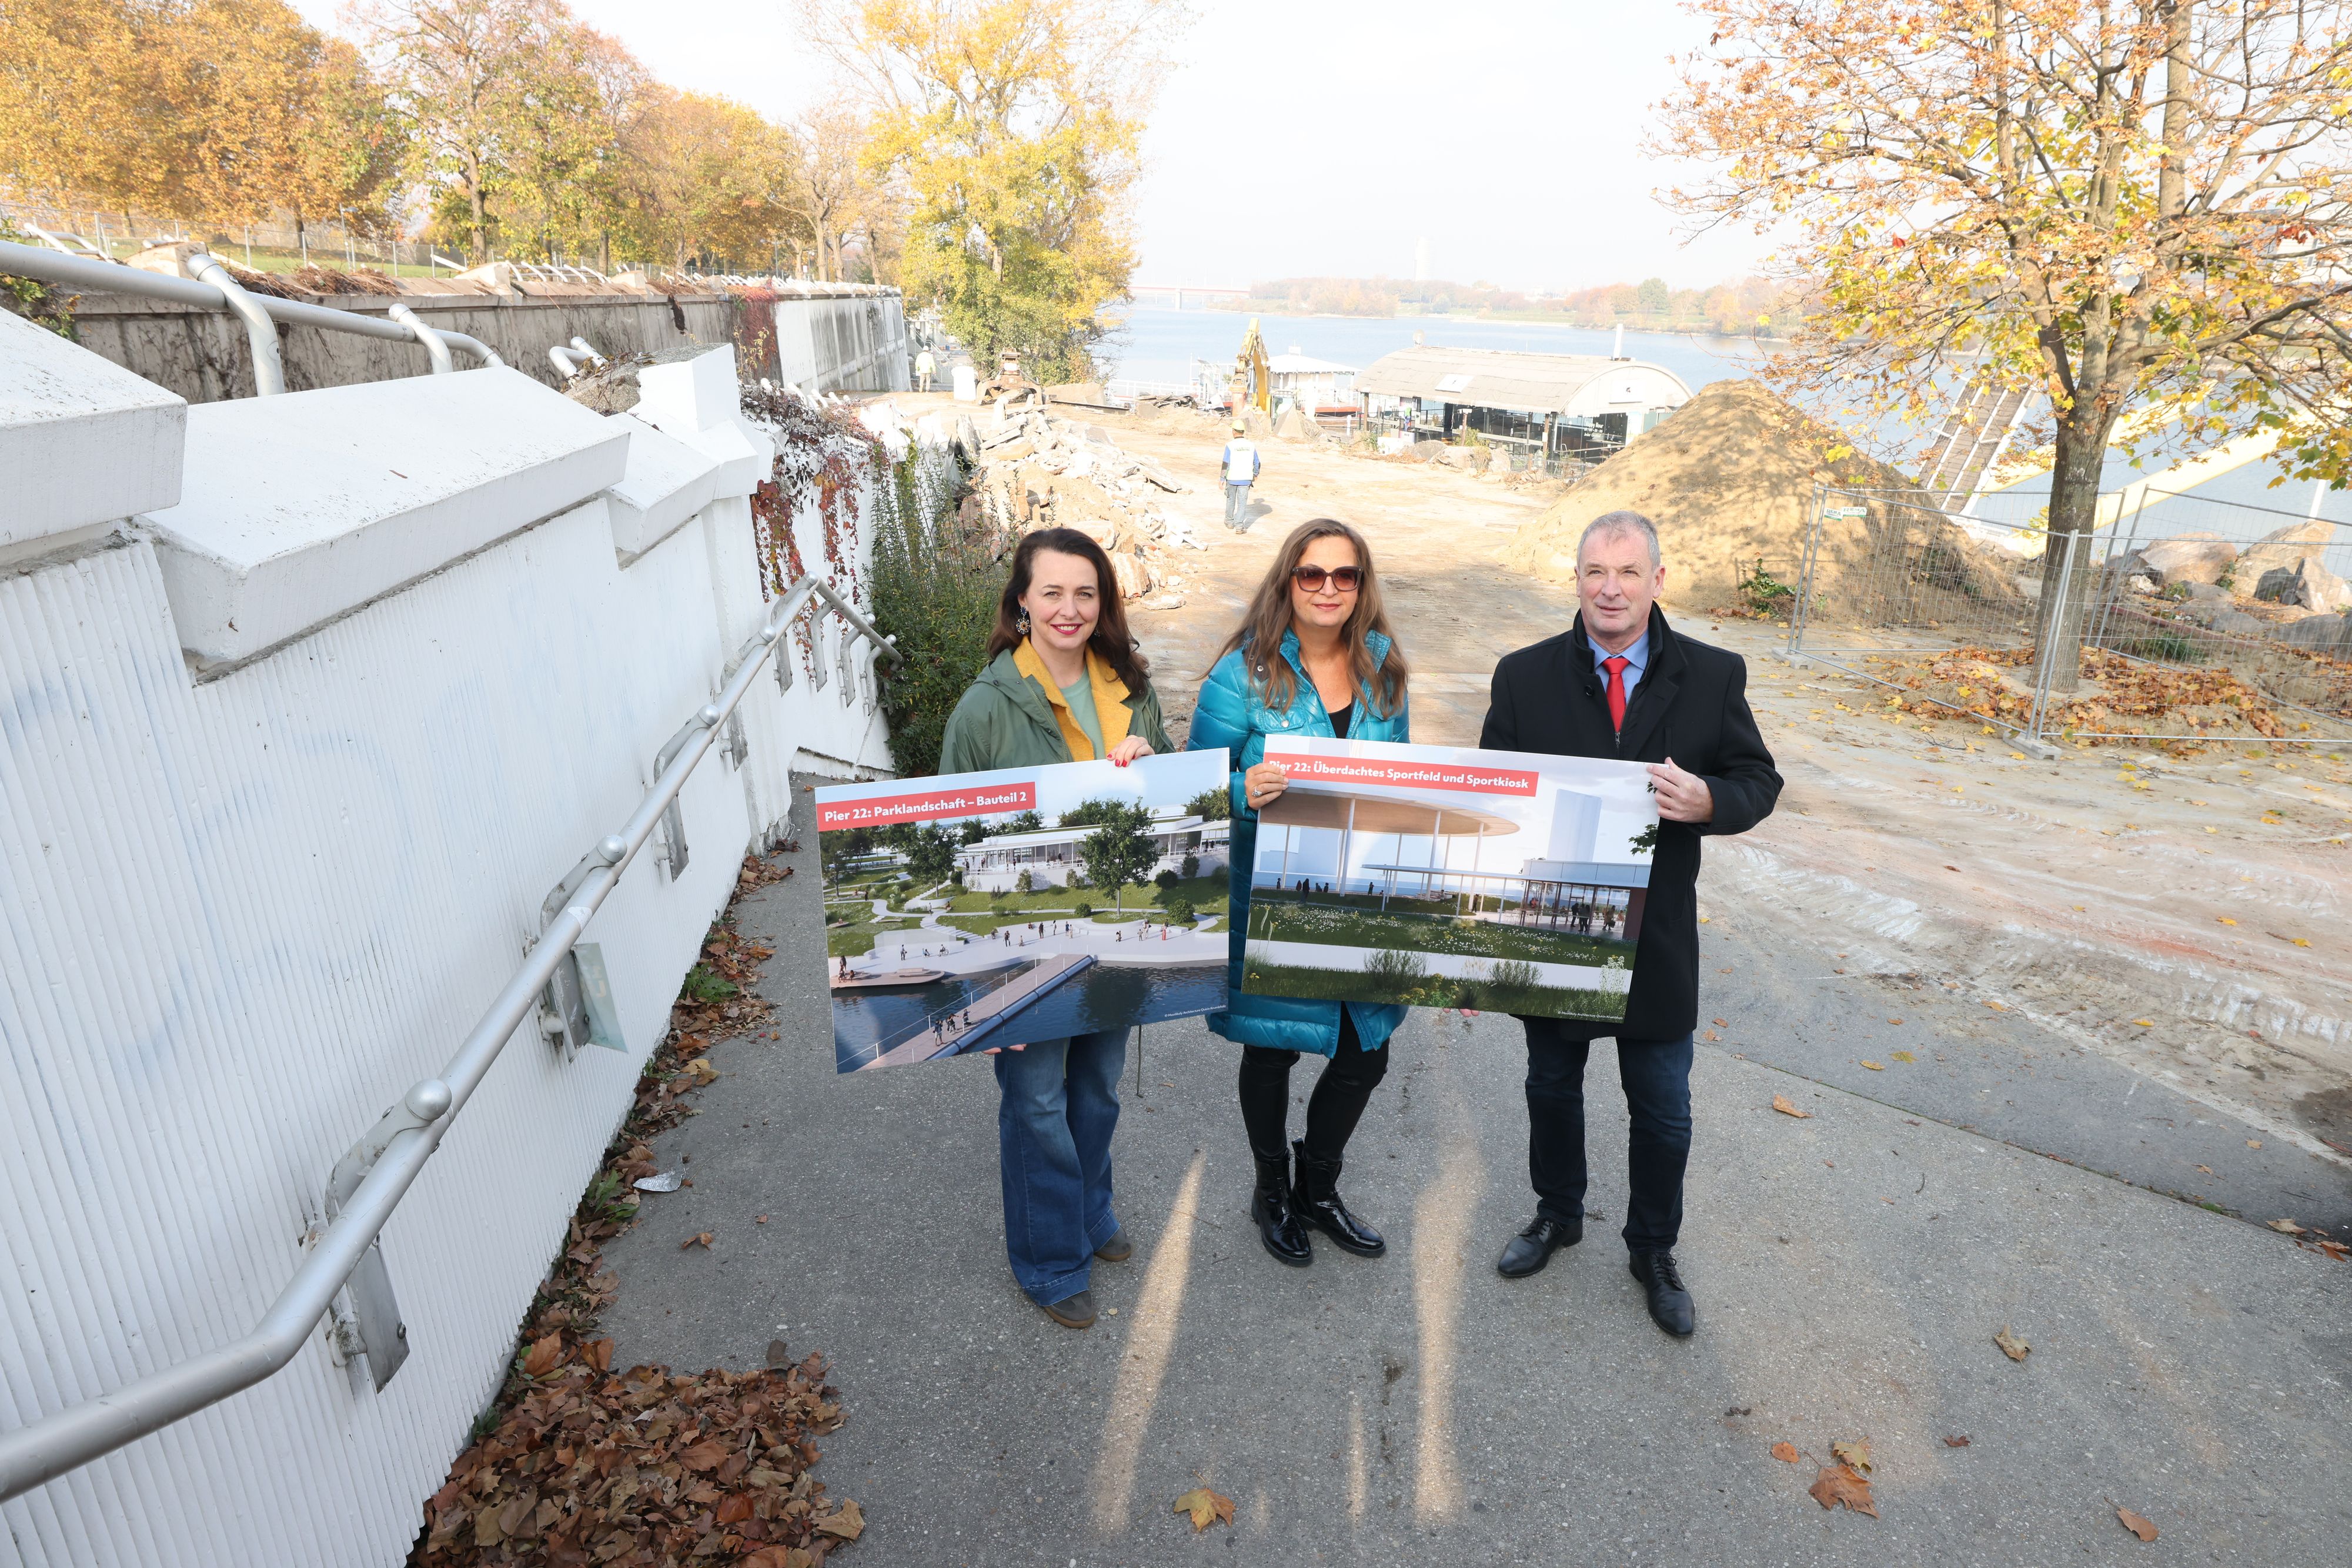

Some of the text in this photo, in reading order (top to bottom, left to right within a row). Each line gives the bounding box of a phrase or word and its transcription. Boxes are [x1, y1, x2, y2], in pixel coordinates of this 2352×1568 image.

[1294, 763, 1311, 772] 22:
[1313, 761, 1385, 778] Überdachtes
[1387, 768, 1440, 783] Sportfeld
[1442, 772, 1464, 784] und
[1466, 775, 1529, 789] Sportkiosk
[824, 811, 850, 822] Pier
[853, 808, 872, 820] 22:
[874, 798, 965, 817] Parklandschaft
[976, 794, 1017, 807] Bauteil
[1020, 791, 1027, 802] 2
